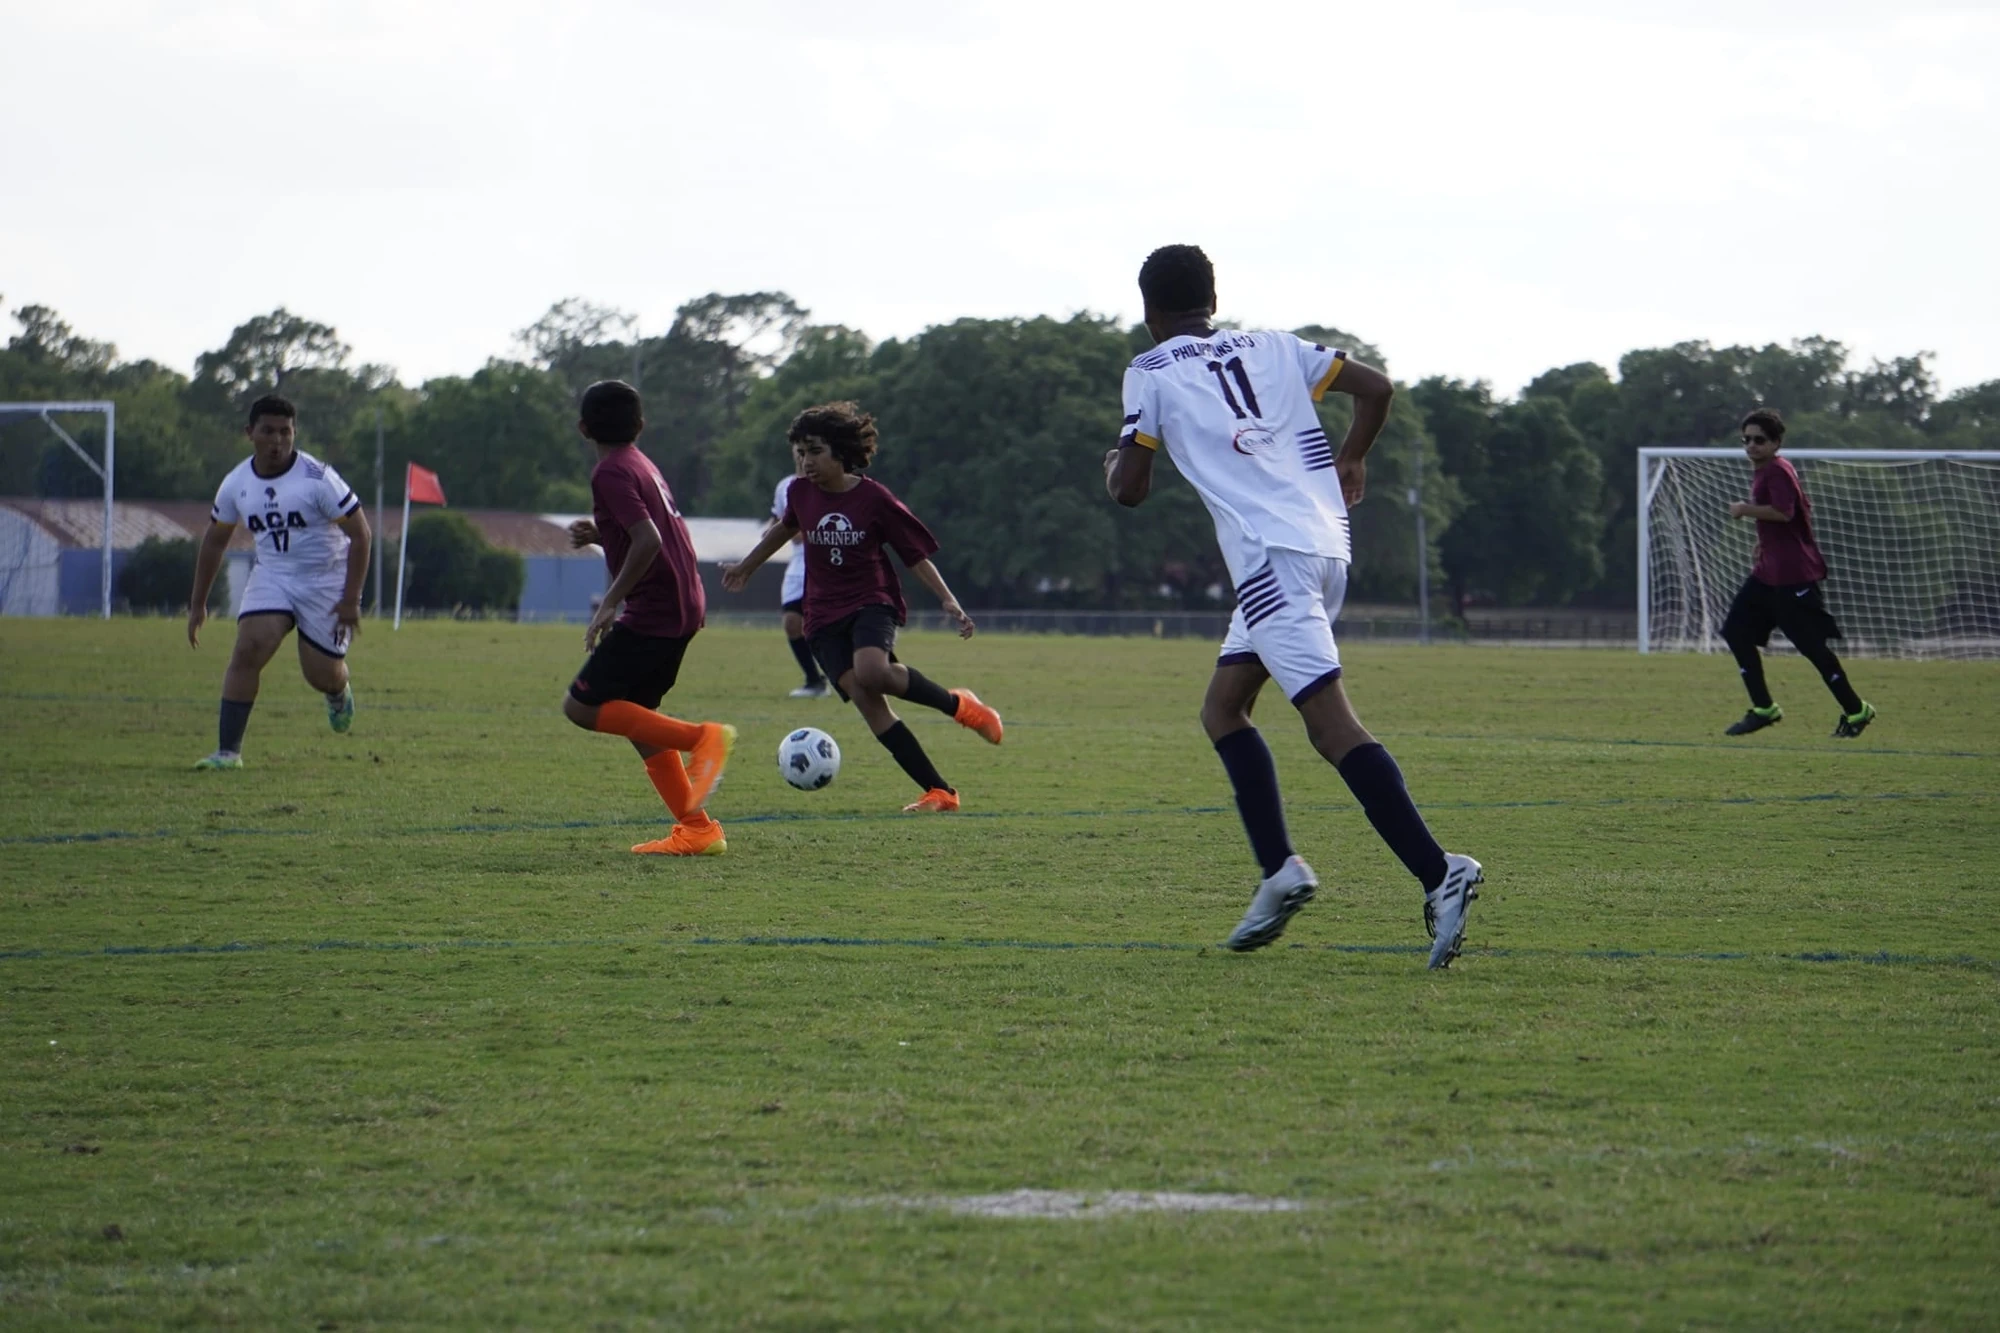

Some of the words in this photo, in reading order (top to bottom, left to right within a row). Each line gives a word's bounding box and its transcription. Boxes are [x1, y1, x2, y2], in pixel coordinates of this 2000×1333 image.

[1206, 356, 1262, 419] 11
[248, 511, 307, 533] ACA
[268, 530, 289, 553] 17
[830, 547, 843, 566] 8
